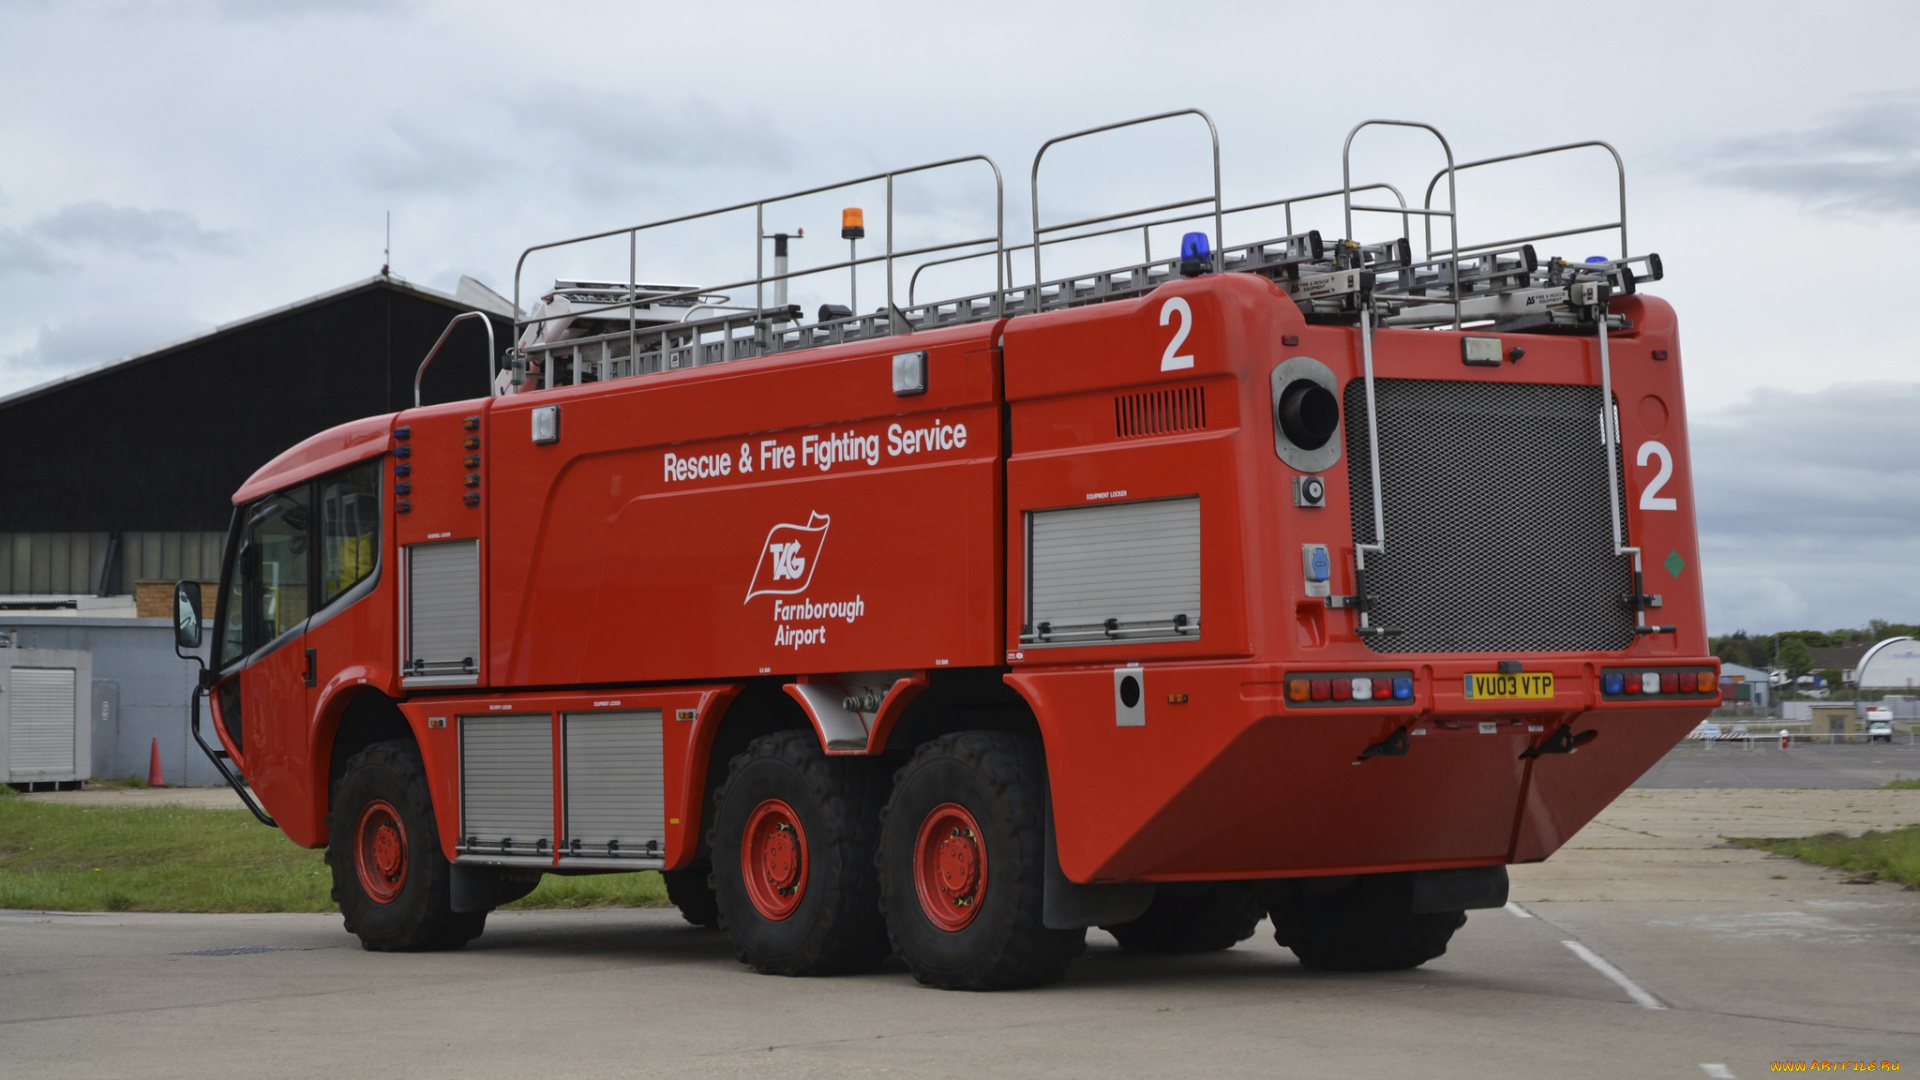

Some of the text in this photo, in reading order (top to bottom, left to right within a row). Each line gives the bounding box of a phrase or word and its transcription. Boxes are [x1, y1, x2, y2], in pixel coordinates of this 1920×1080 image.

[1159, 296, 1195, 372] 2
[664, 419, 967, 482] Rescue & Fire Fighting Service
[1636, 440, 1678, 511] 2
[769, 538, 806, 581] TAG
[774, 595, 865, 624] Farnborough
[774, 625, 826, 651] Airport
[1476, 676, 1552, 696] VU03 VTP
